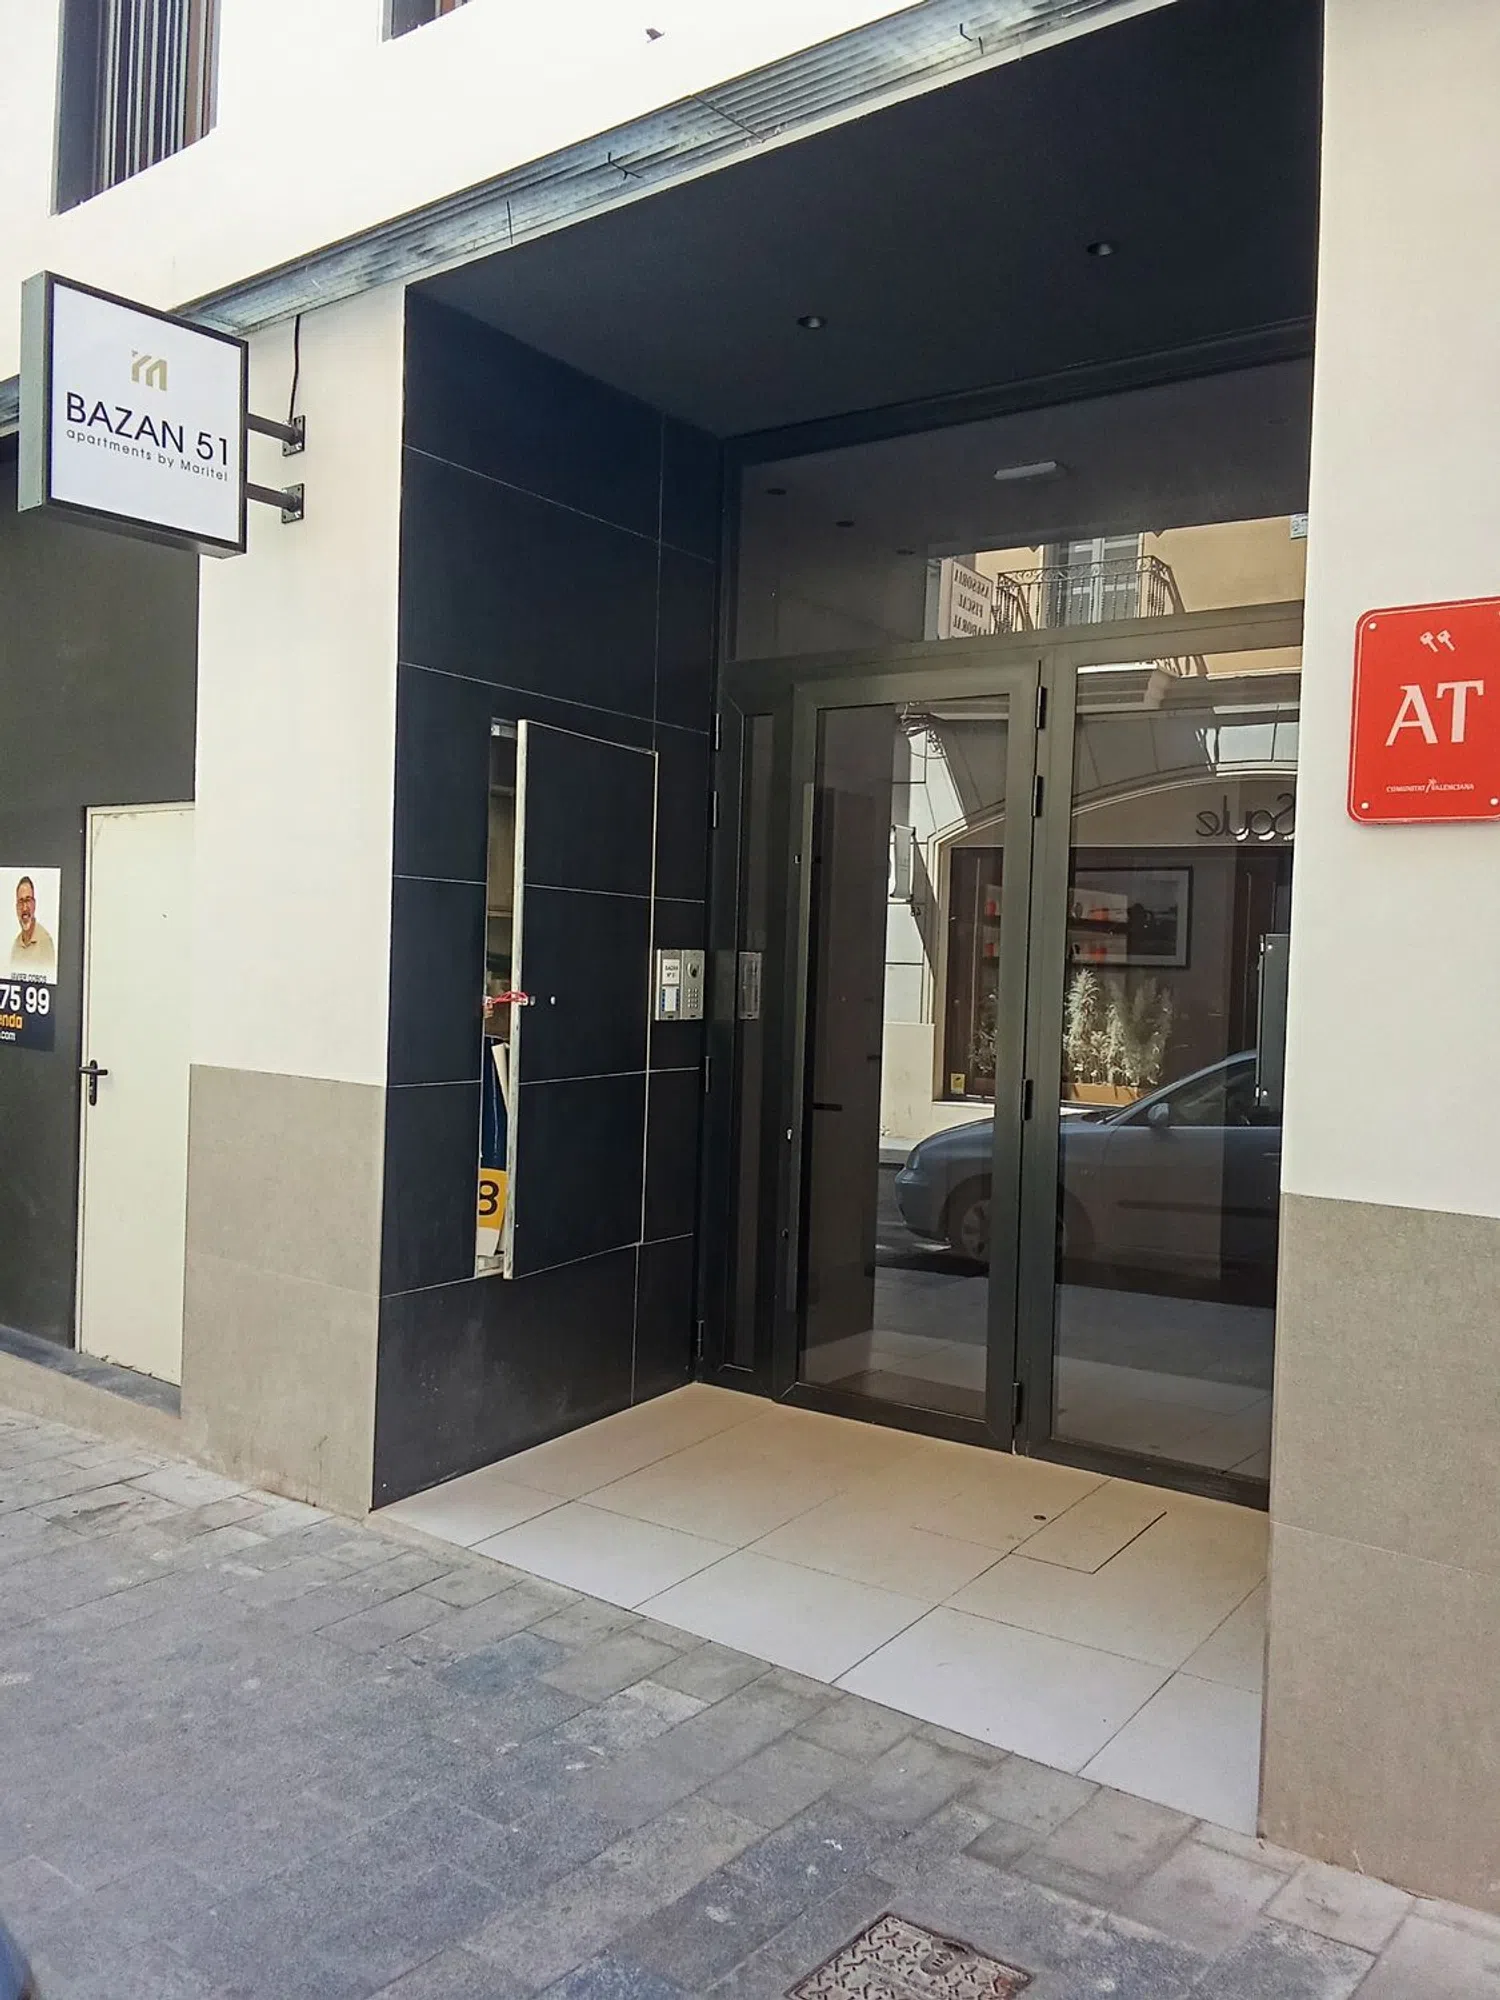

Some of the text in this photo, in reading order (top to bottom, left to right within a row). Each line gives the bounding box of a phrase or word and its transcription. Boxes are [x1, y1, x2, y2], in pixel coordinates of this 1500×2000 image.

[66, 391, 228, 466] BAZAN 51
[66, 428, 228, 482] apartments by Maritel
[1385, 679, 1485, 747] AT
[0, 984, 50, 1015] 75 99
